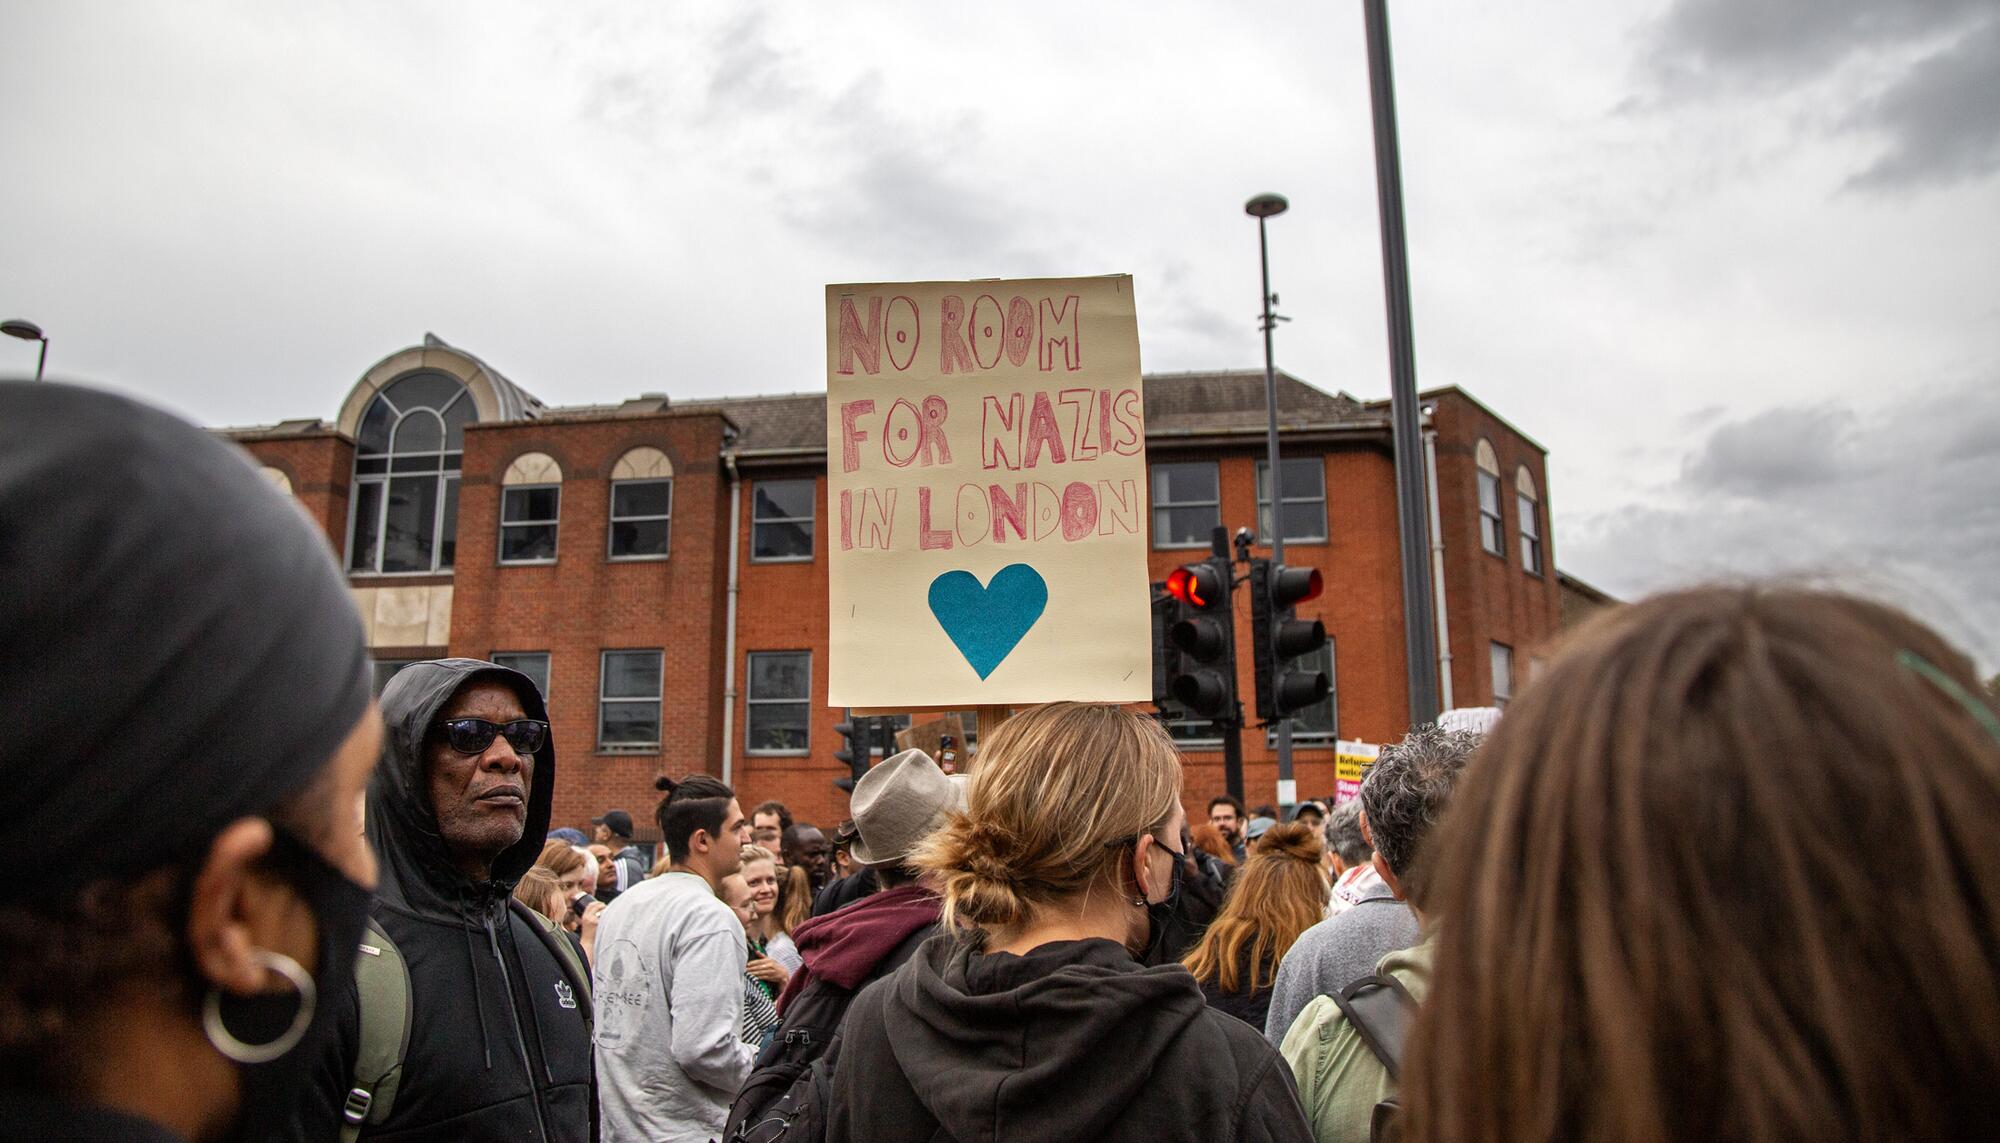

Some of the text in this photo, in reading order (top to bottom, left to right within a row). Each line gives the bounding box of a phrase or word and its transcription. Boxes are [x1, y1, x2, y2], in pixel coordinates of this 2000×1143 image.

[837, 295, 1081, 374] NO ROOM
[841, 388, 1144, 472] FOR NAZIS
[840, 479, 1139, 551] IN LONDON
[1339, 768, 1361, 777] welc
